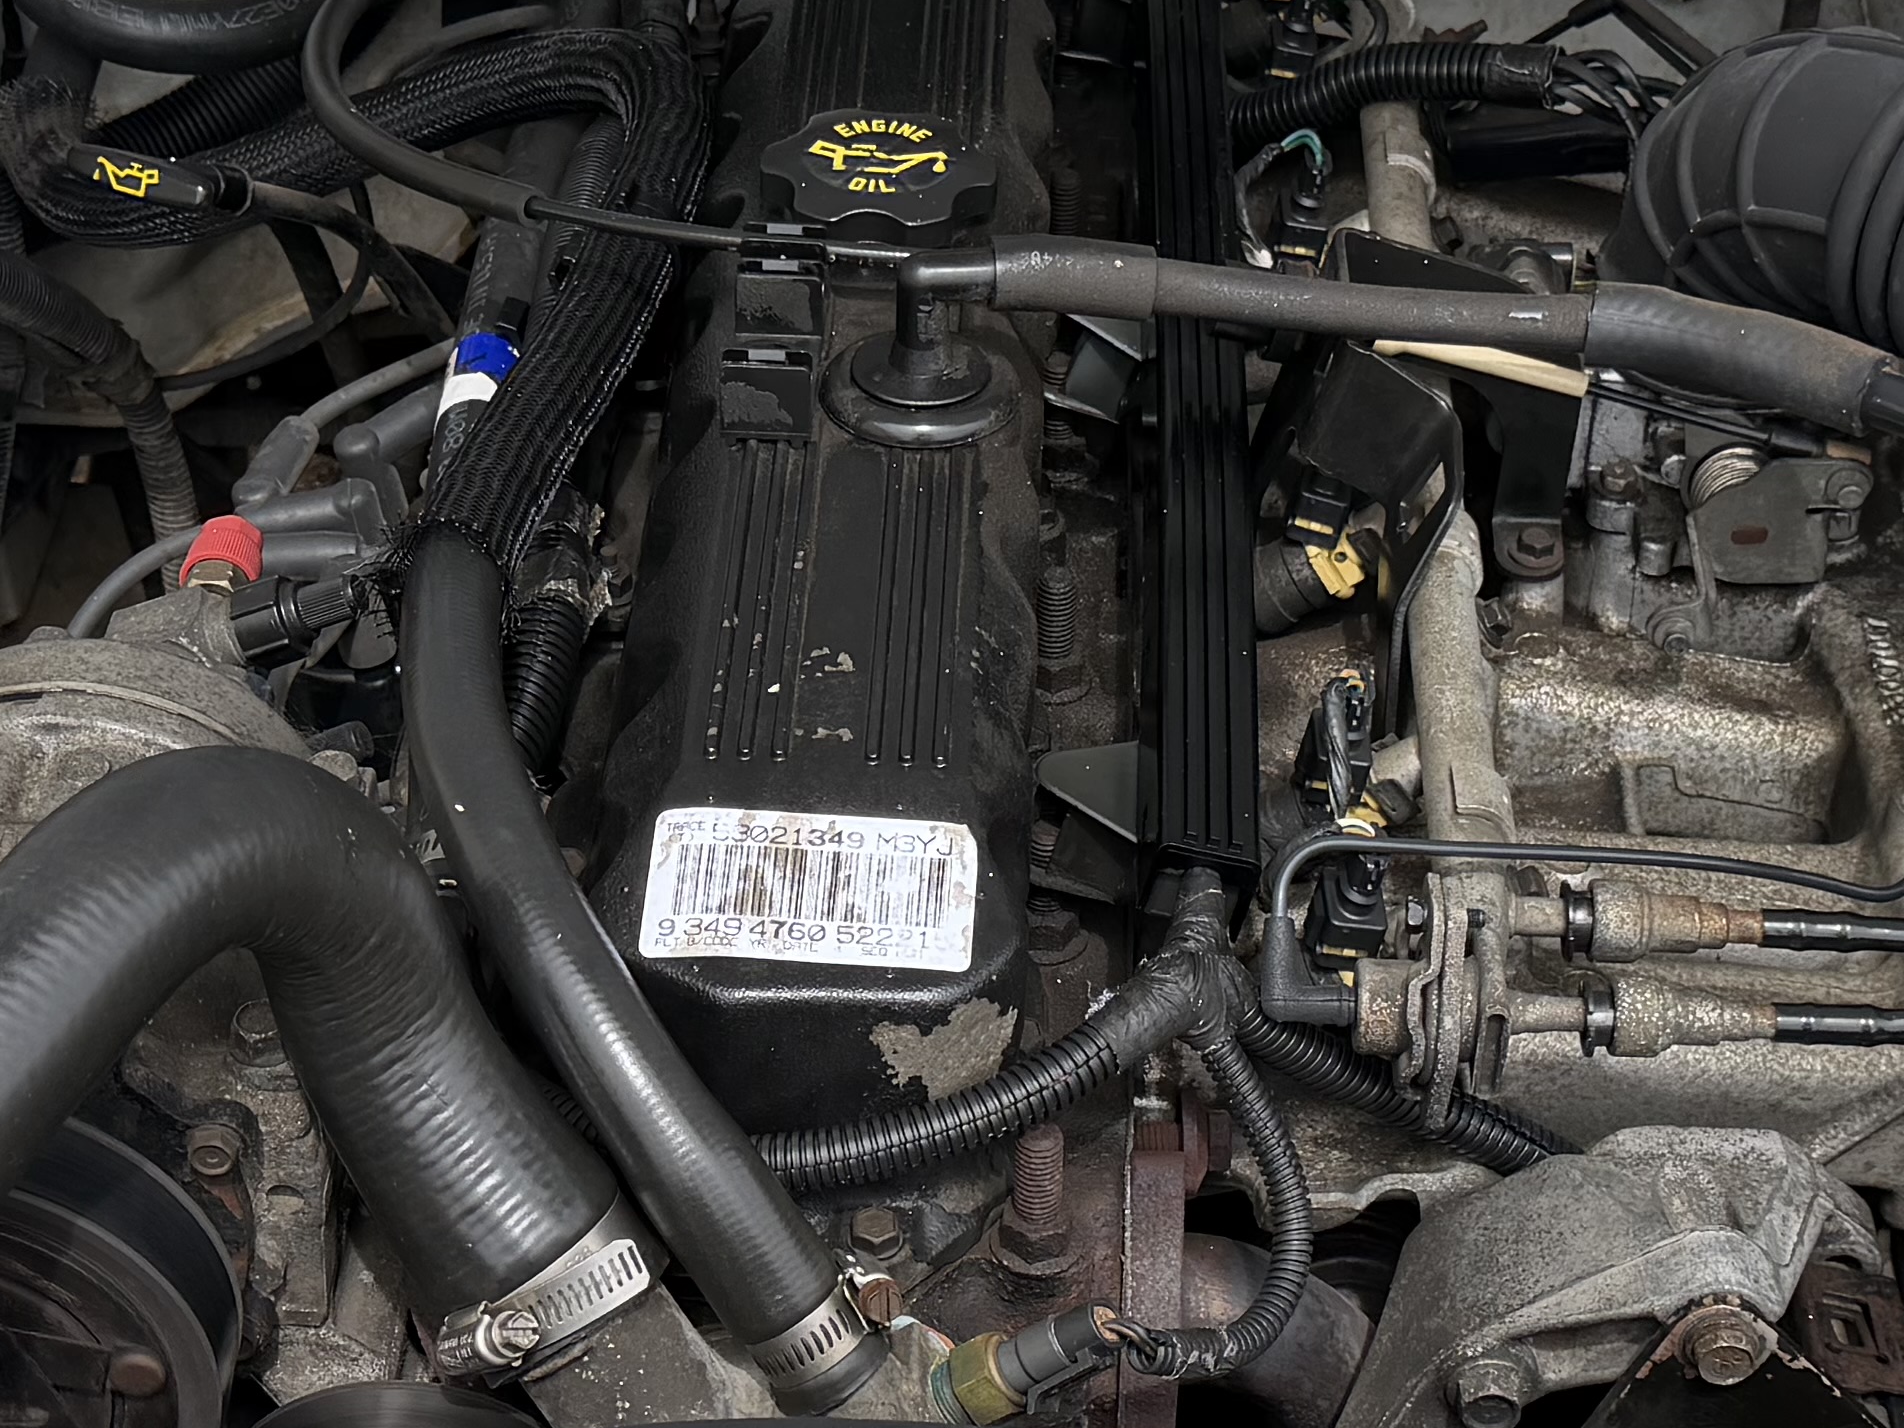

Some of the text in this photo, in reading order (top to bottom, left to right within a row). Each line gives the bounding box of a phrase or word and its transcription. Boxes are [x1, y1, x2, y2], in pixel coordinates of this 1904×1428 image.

[833, 119, 933, 143] ENGINE
[848, 177, 895, 193] OIL
[658, 918, 676, 937] 9
[684, 917, 742, 937] 349
[749, 920, 827, 942] 4760
